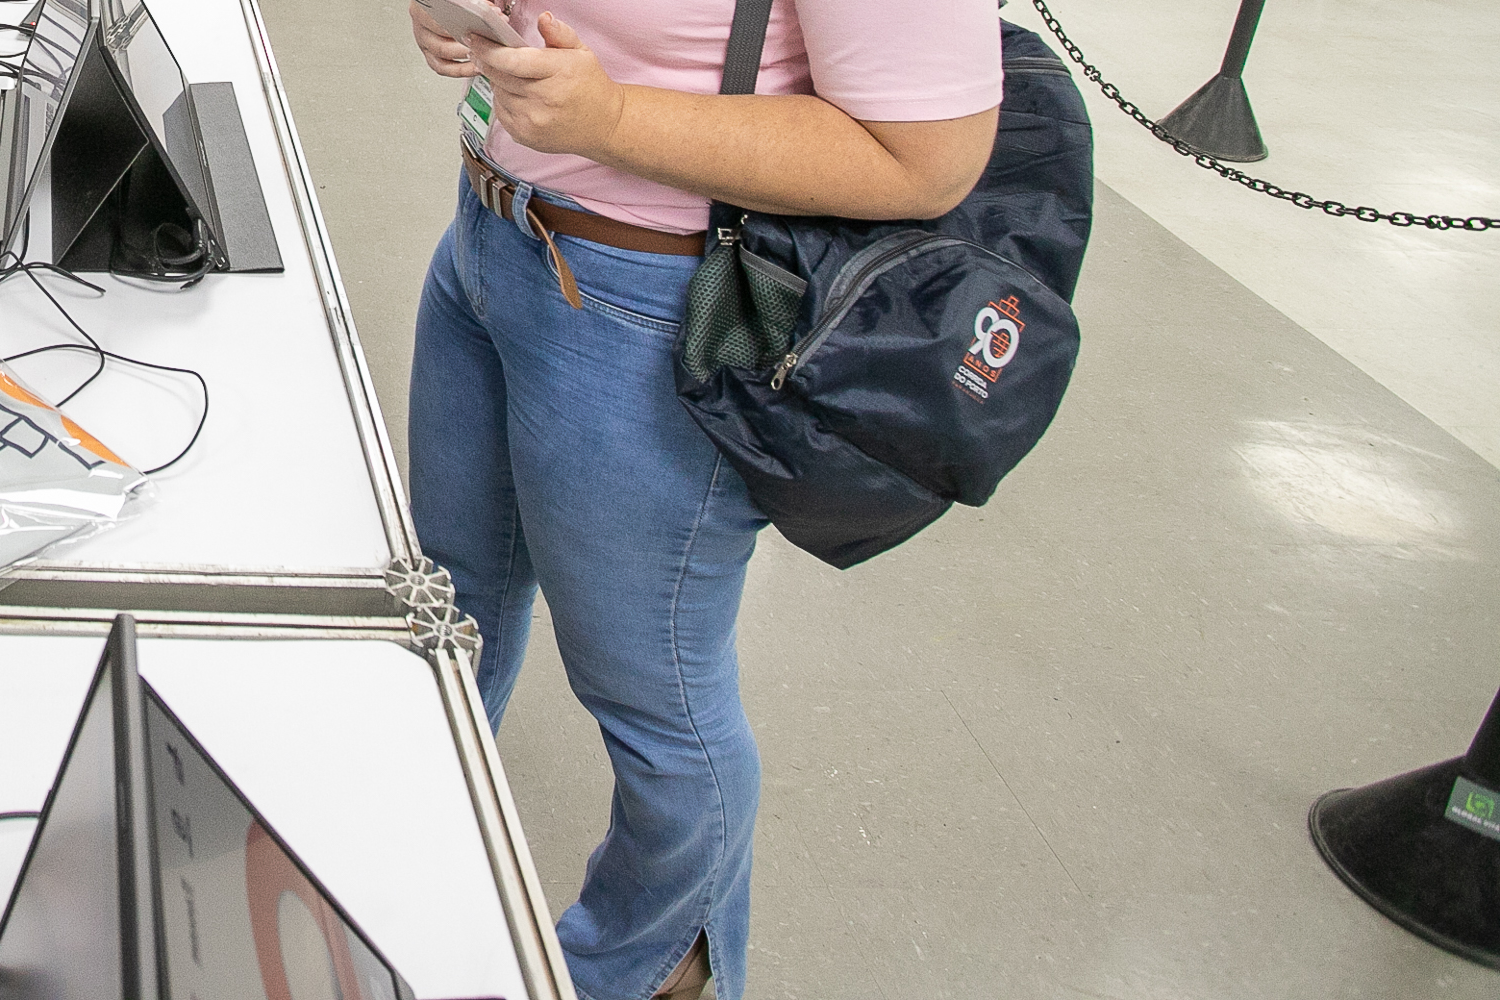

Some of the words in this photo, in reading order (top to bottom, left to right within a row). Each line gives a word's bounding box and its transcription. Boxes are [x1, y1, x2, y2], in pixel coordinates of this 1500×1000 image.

[968, 306, 1020, 368] 90
[958, 365, 988, 389] CORRIDA
[967, 355, 997, 378] ANOS
[954, 372, 966, 384] DO
[965, 379, 989, 399] PORTO
